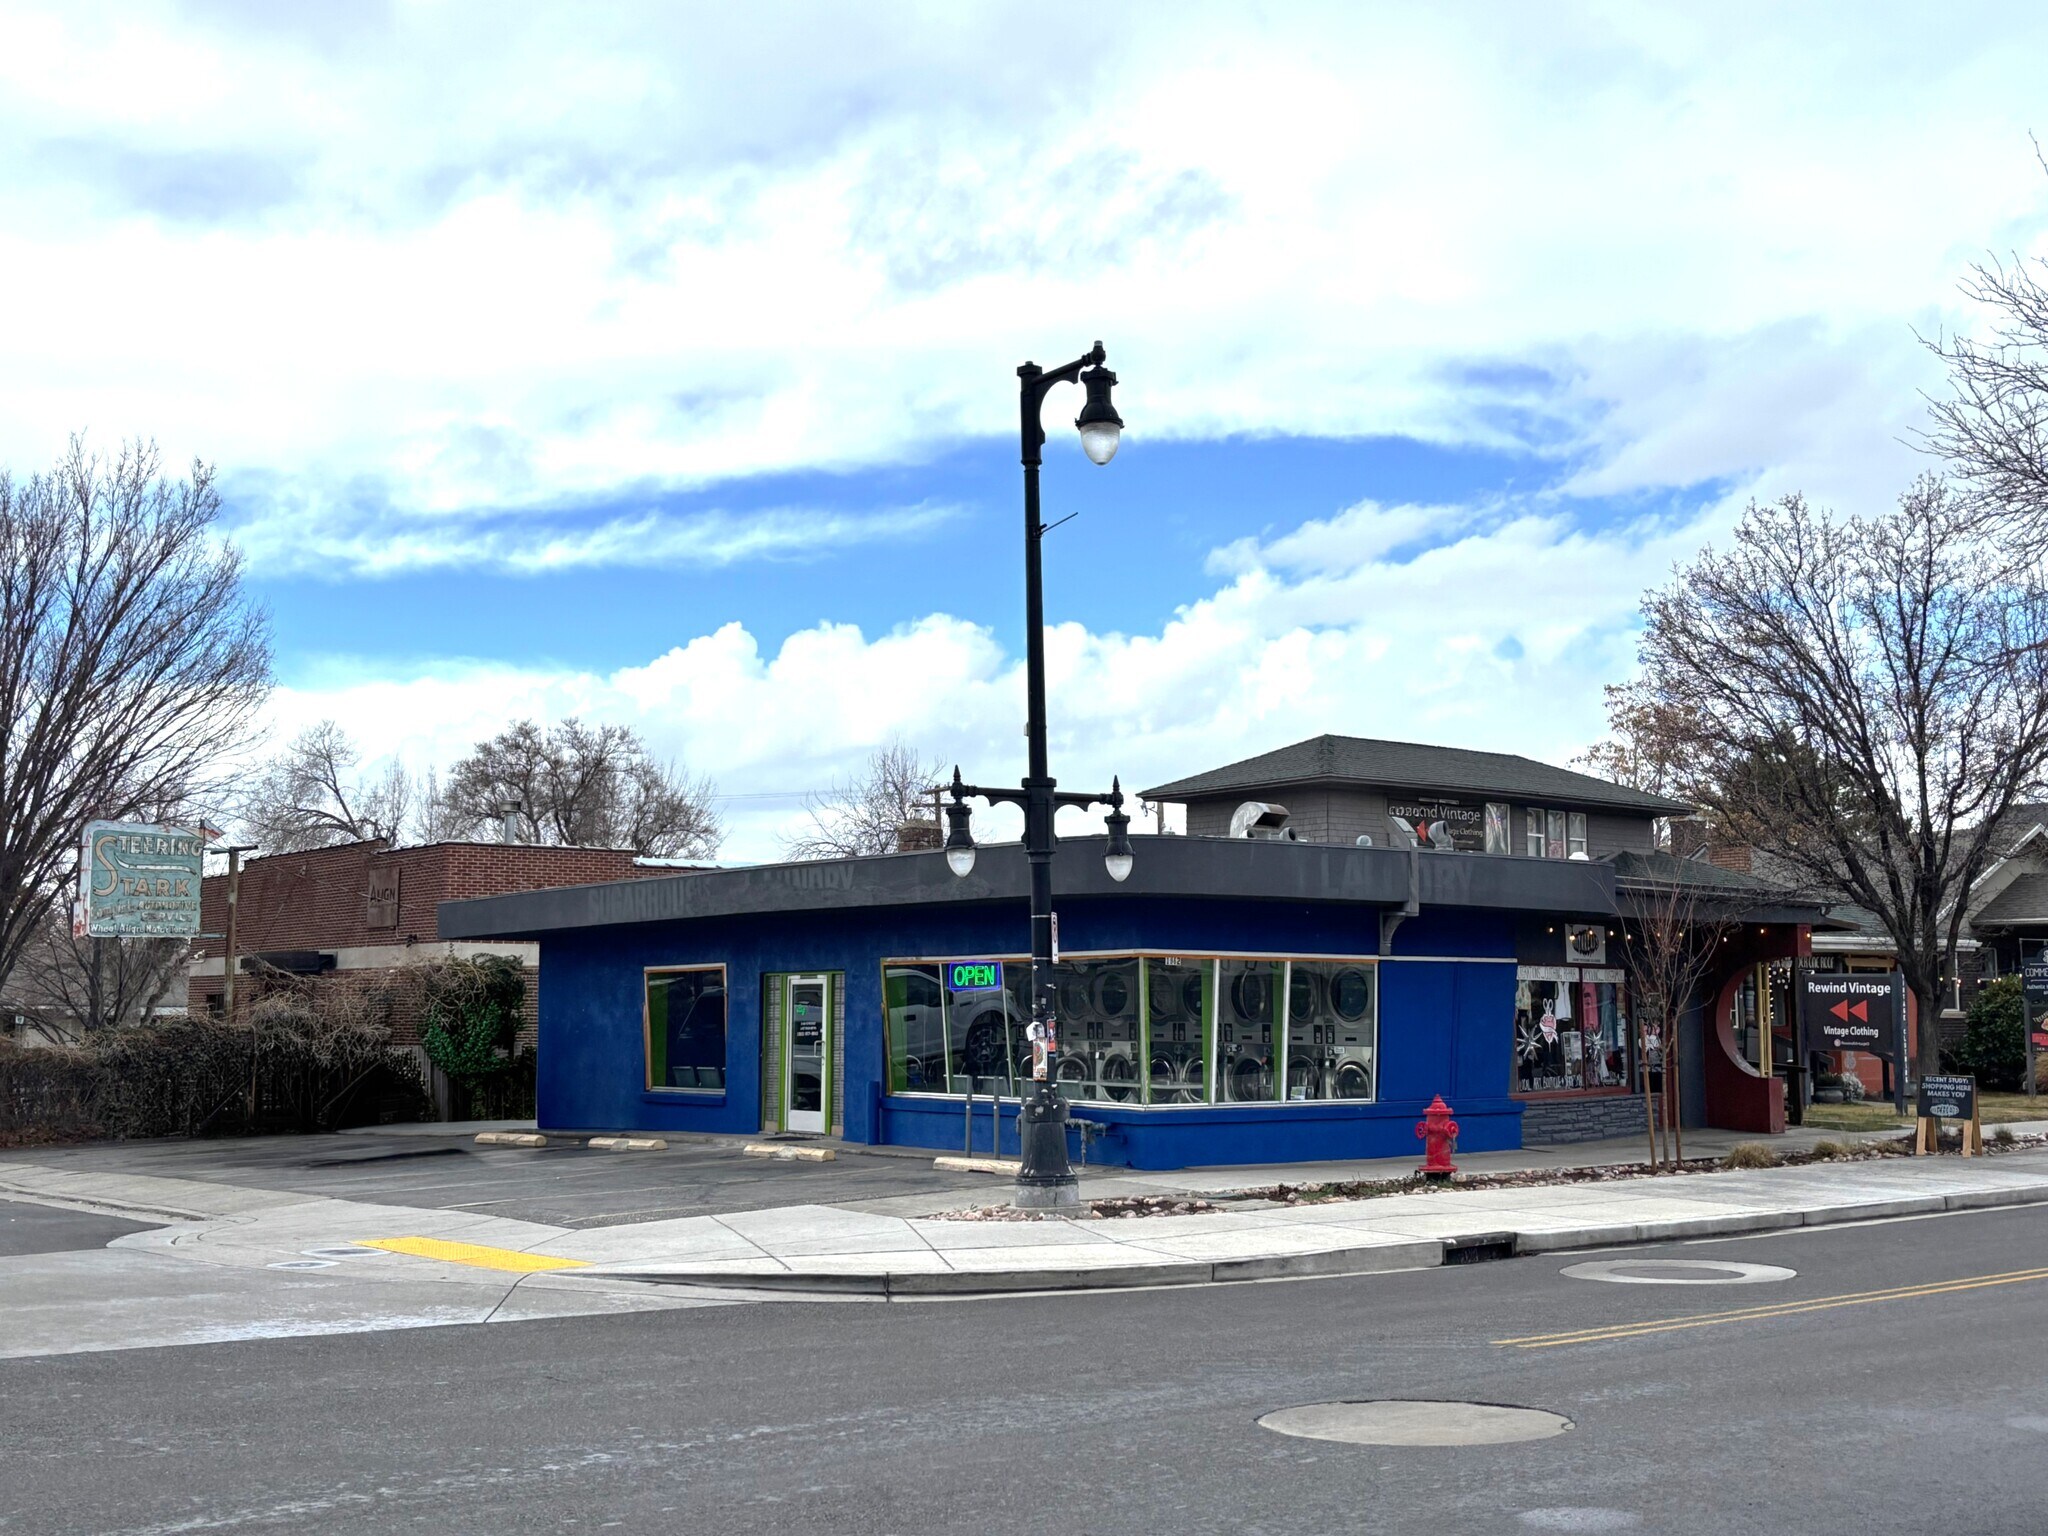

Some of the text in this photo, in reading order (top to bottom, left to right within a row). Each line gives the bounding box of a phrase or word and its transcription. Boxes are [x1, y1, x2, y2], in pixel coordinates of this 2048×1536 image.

[1440, 806, 1481, 824] Vintage
[954, 965, 995, 986] OPEN
[1808, 982, 1891, 996] Rewind Vintage
[1823, 1026, 1879, 1038] Vintage Clothing
